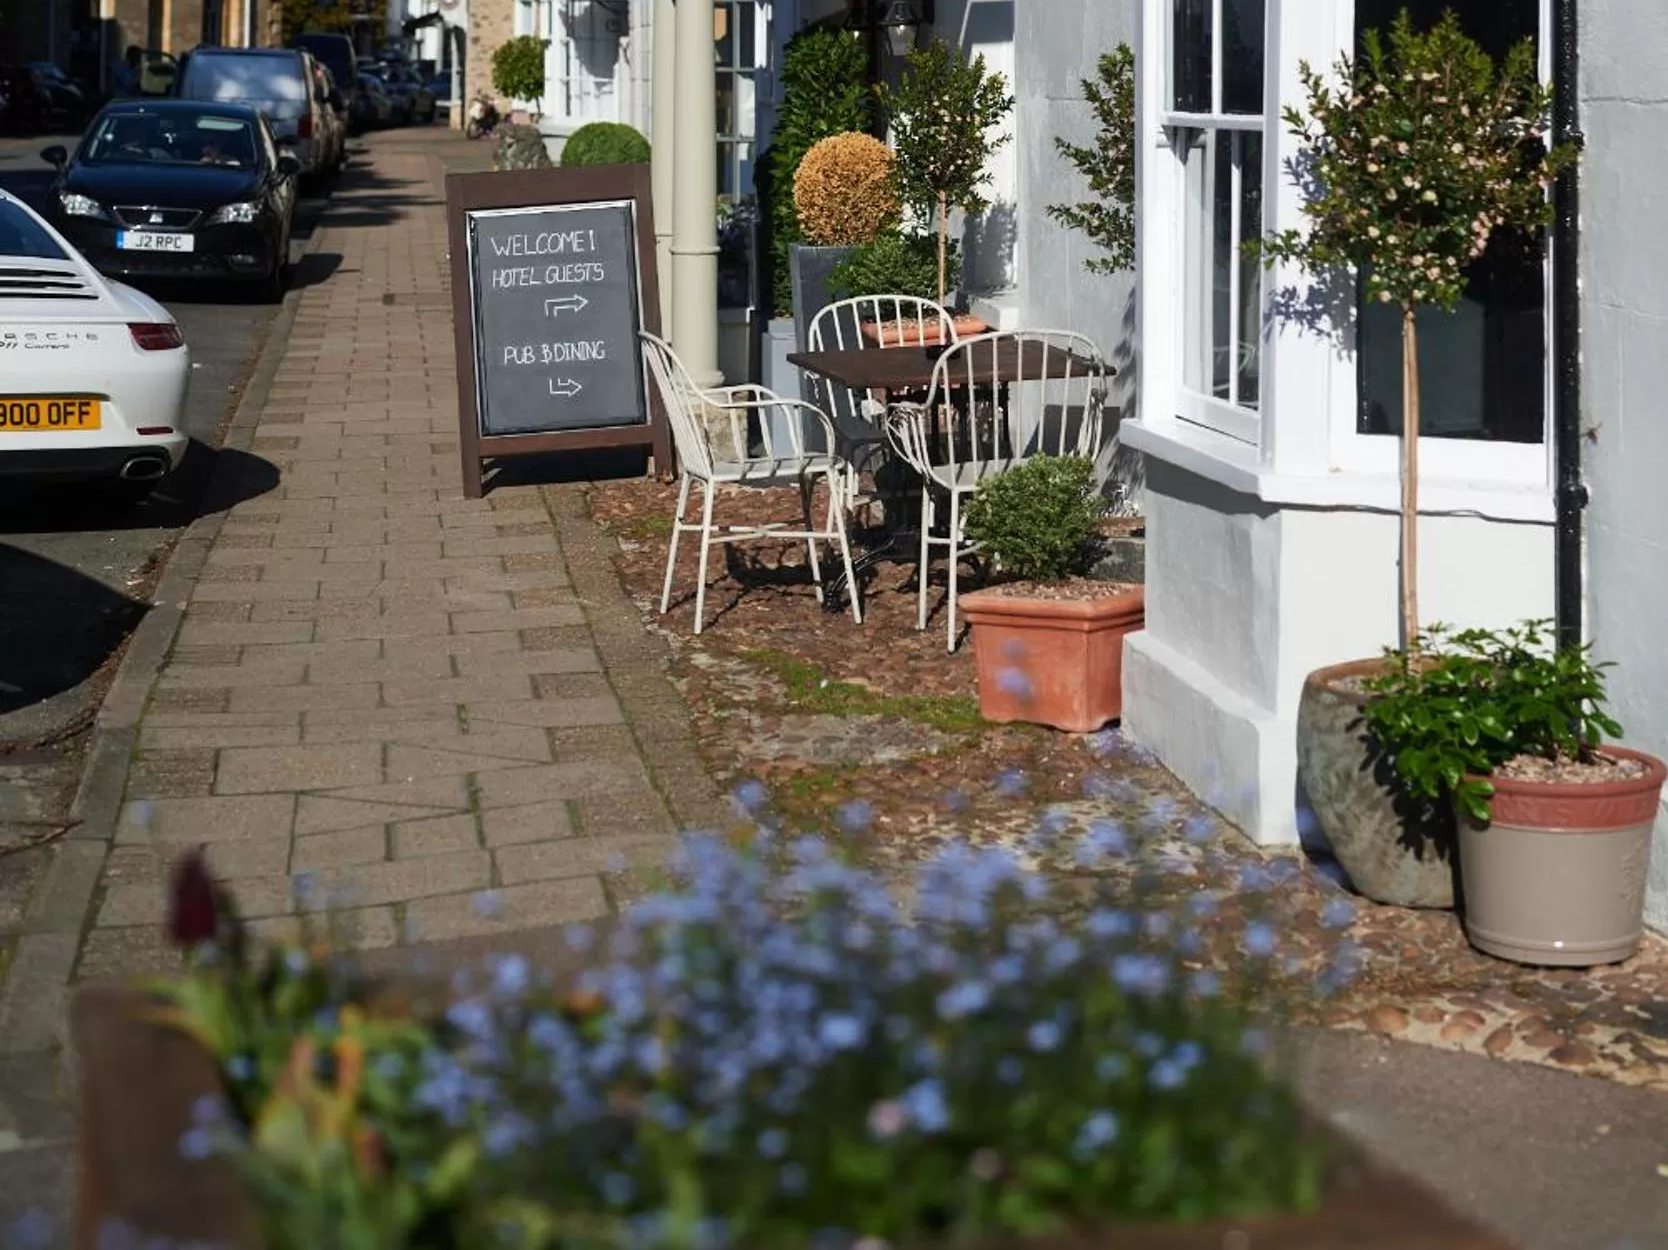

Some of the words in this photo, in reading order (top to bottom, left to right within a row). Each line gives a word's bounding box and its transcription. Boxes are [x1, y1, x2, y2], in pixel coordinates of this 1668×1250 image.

[135, 235, 152, 247] J2
[156, 236, 182, 248] RPC
[491, 230, 595, 256] WELCOME!
[493, 266, 542, 287] HOTEL
[545, 263, 604, 283] GUESTS
[504, 346, 535, 365] PUB
[554, 341, 605, 361] DINING
